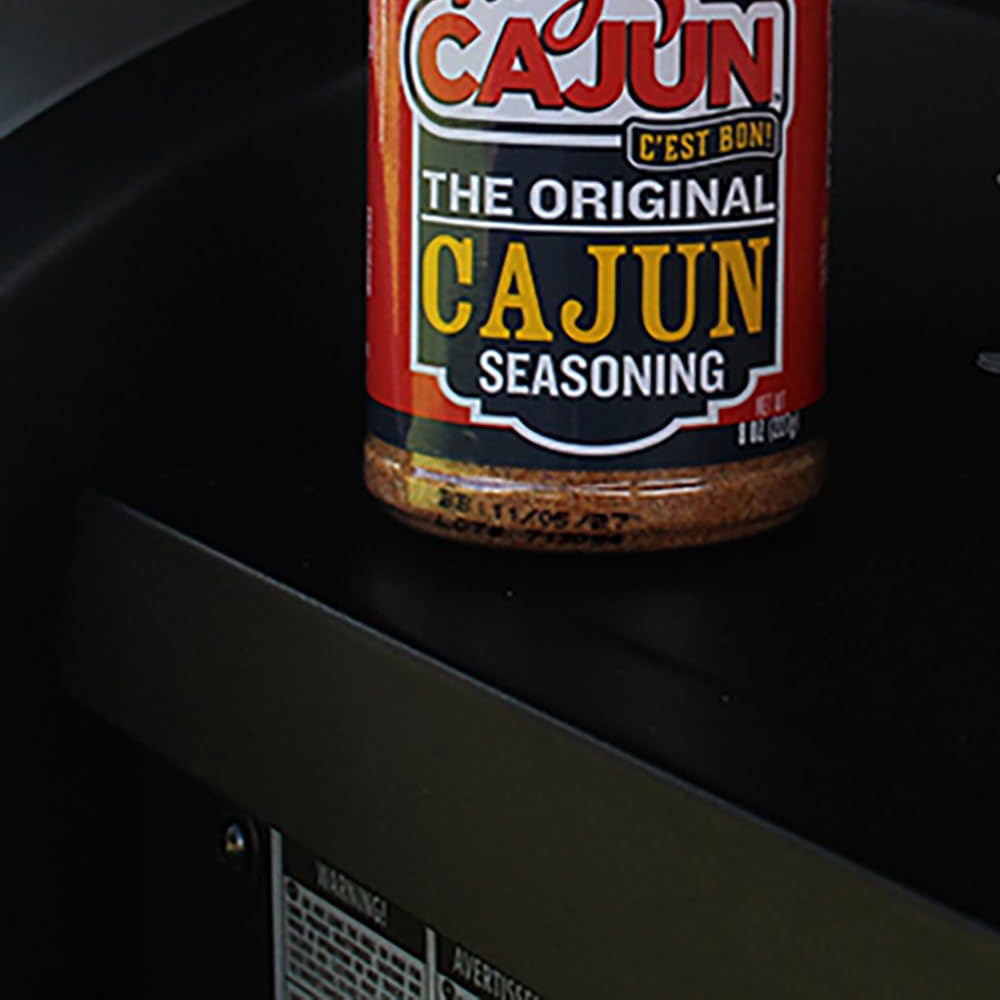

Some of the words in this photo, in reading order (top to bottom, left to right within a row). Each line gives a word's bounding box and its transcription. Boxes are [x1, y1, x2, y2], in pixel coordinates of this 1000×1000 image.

[417, 13, 775, 113] CAJUN
[638, 129, 710, 163] C'EST
[718, 119, 774, 154] BON!
[421, 169, 514, 217] THE
[528, 173, 776, 221] ORIGINAL
[420, 233, 771, 344] CAJUN
[478, 349, 725, 398] SEASONING
